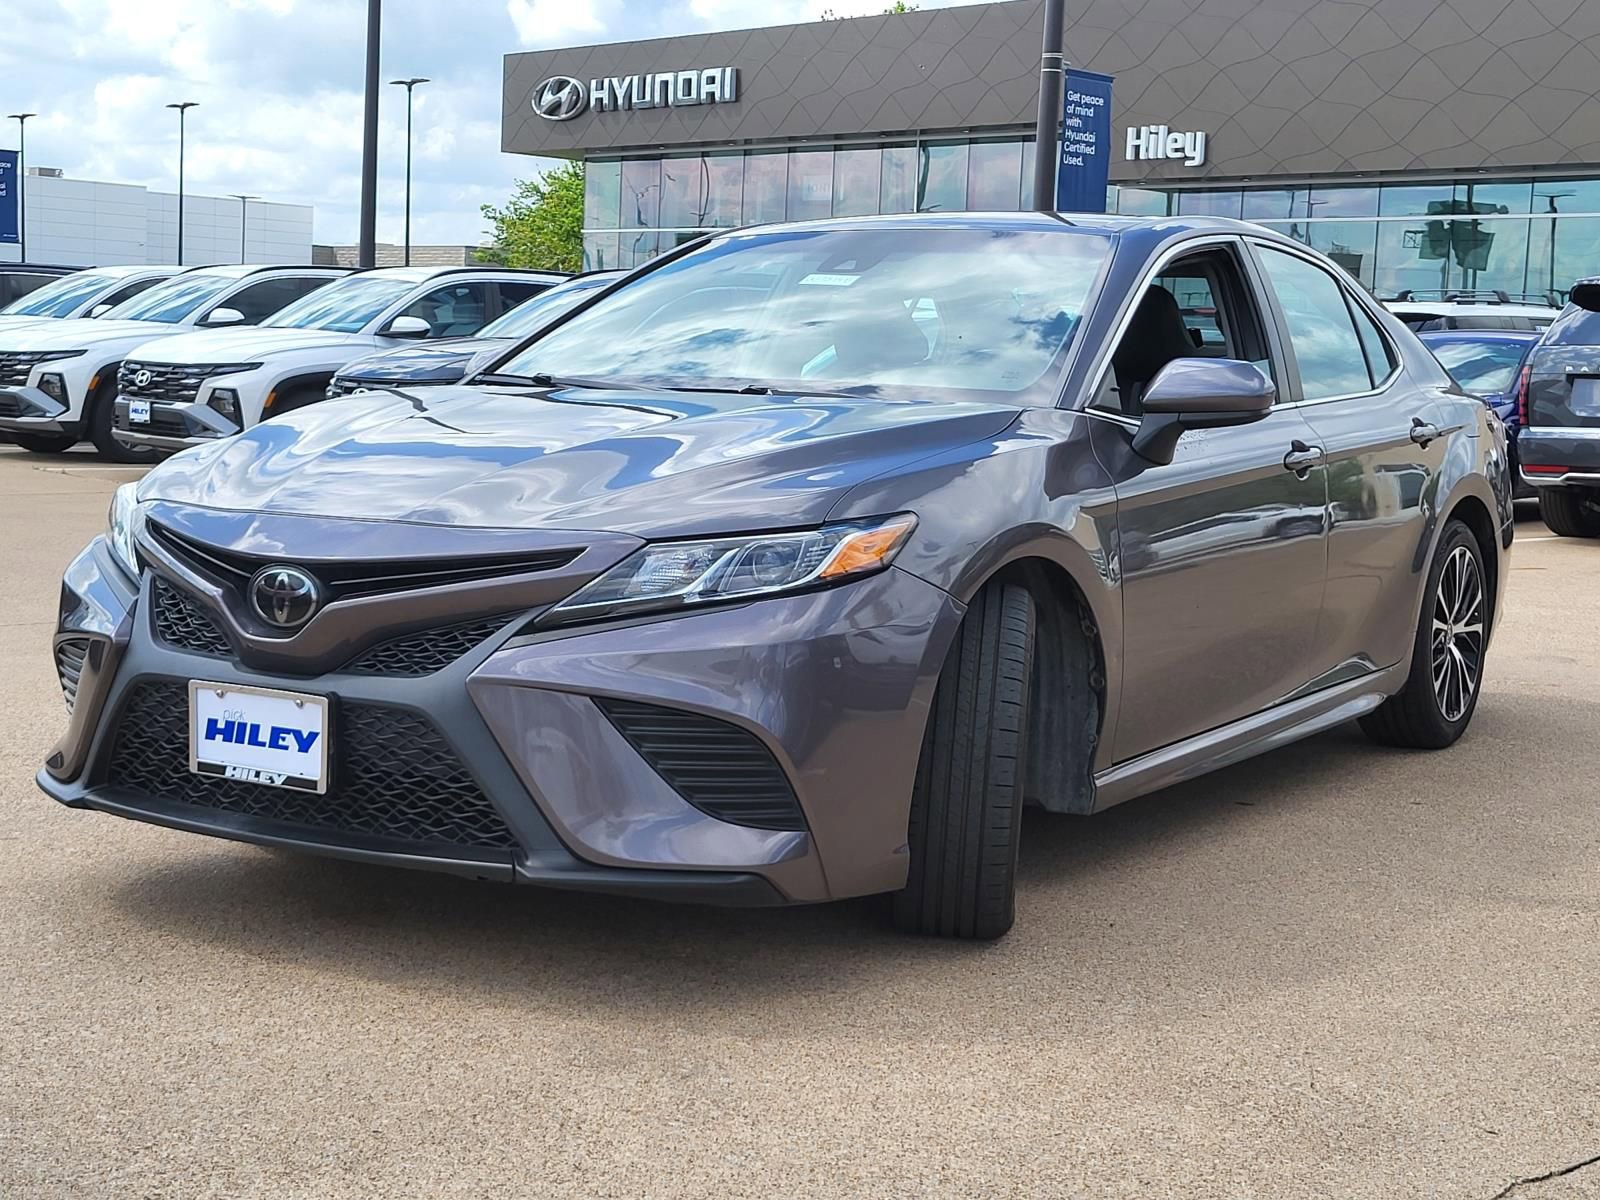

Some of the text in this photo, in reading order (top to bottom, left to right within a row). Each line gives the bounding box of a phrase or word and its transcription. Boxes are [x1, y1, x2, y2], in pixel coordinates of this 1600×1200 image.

[590, 67, 736, 111] HYUNDAI
[1067, 90, 1104, 106] Get peace
[1066, 103, 1094, 117] of mind
[1066, 116, 1082, 128] with
[1065, 129, 1096, 143] Hyundai
[1064, 141, 1095, 155] Certified
[1125, 125, 1206, 167] Hiley
[1063, 153, 1084, 166] Used.
[205, 717, 320, 754] HILEY
[224, 765, 288, 785] HILEY
